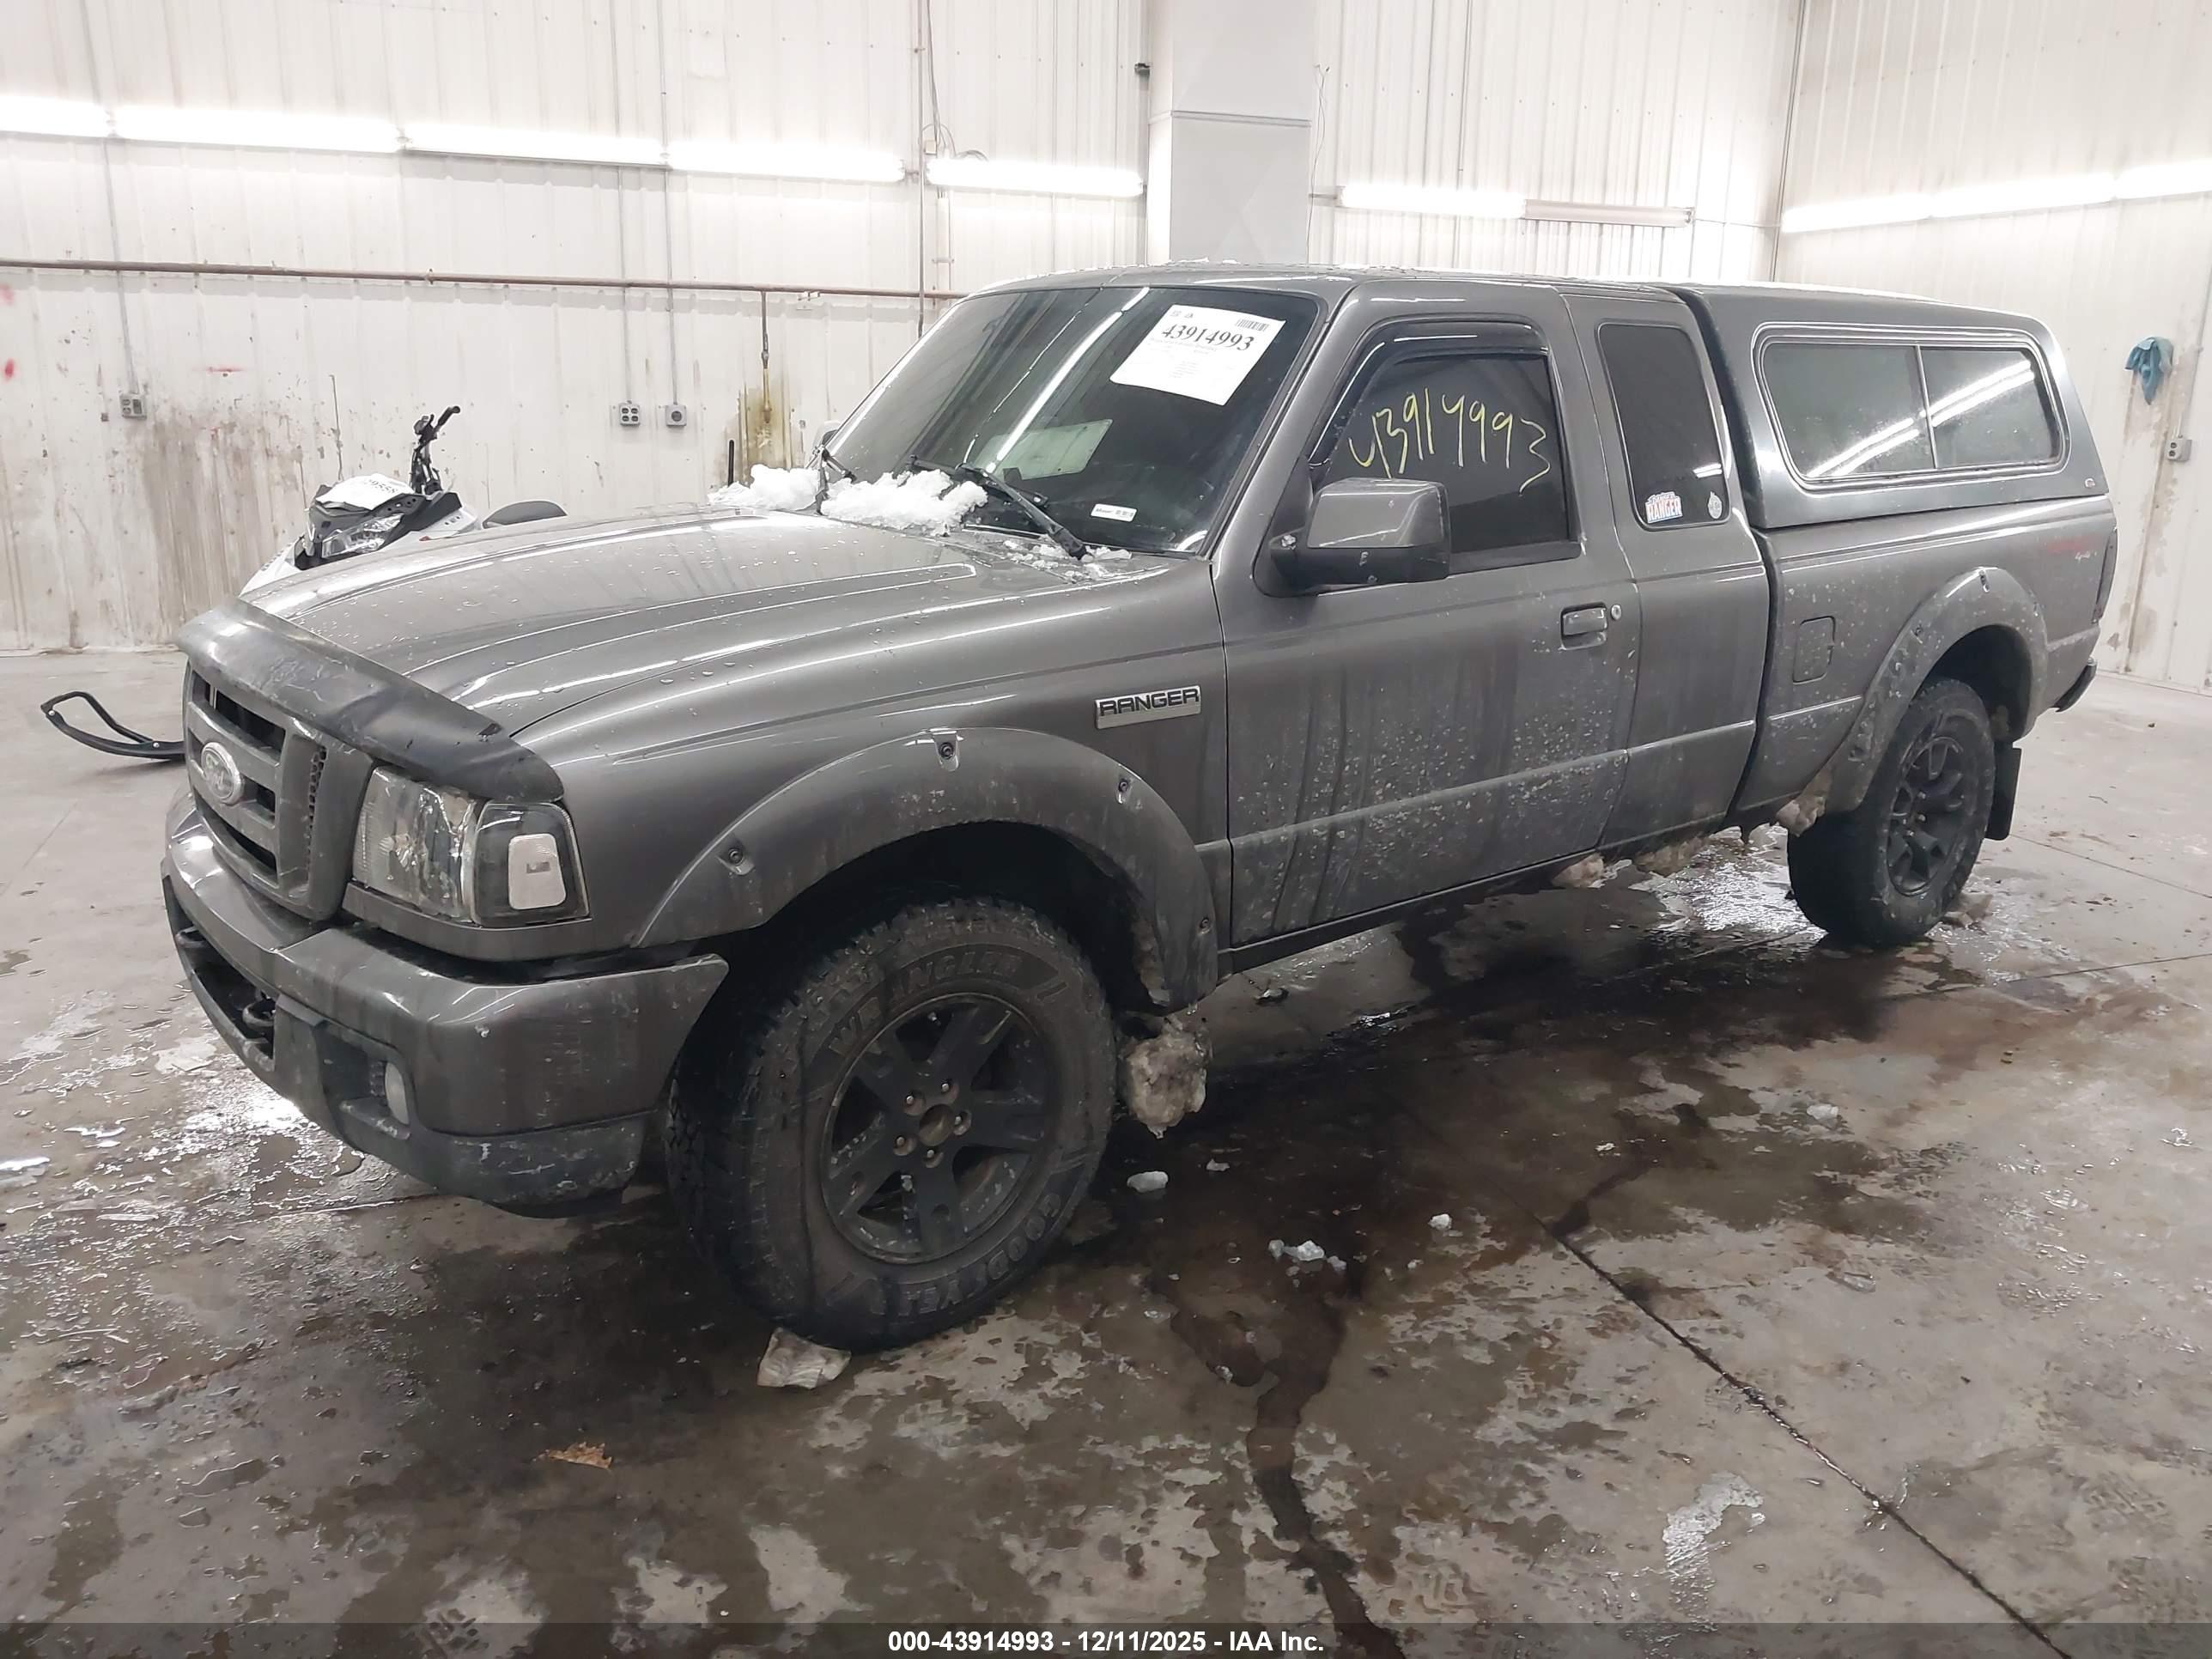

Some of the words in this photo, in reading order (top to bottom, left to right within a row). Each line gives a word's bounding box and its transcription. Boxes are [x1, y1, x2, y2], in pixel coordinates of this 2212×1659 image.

[1162, 323, 1255, 351] 43914993
[1347, 387, 1552, 498] 43914993
[1099, 688, 1200, 717] RANGER
